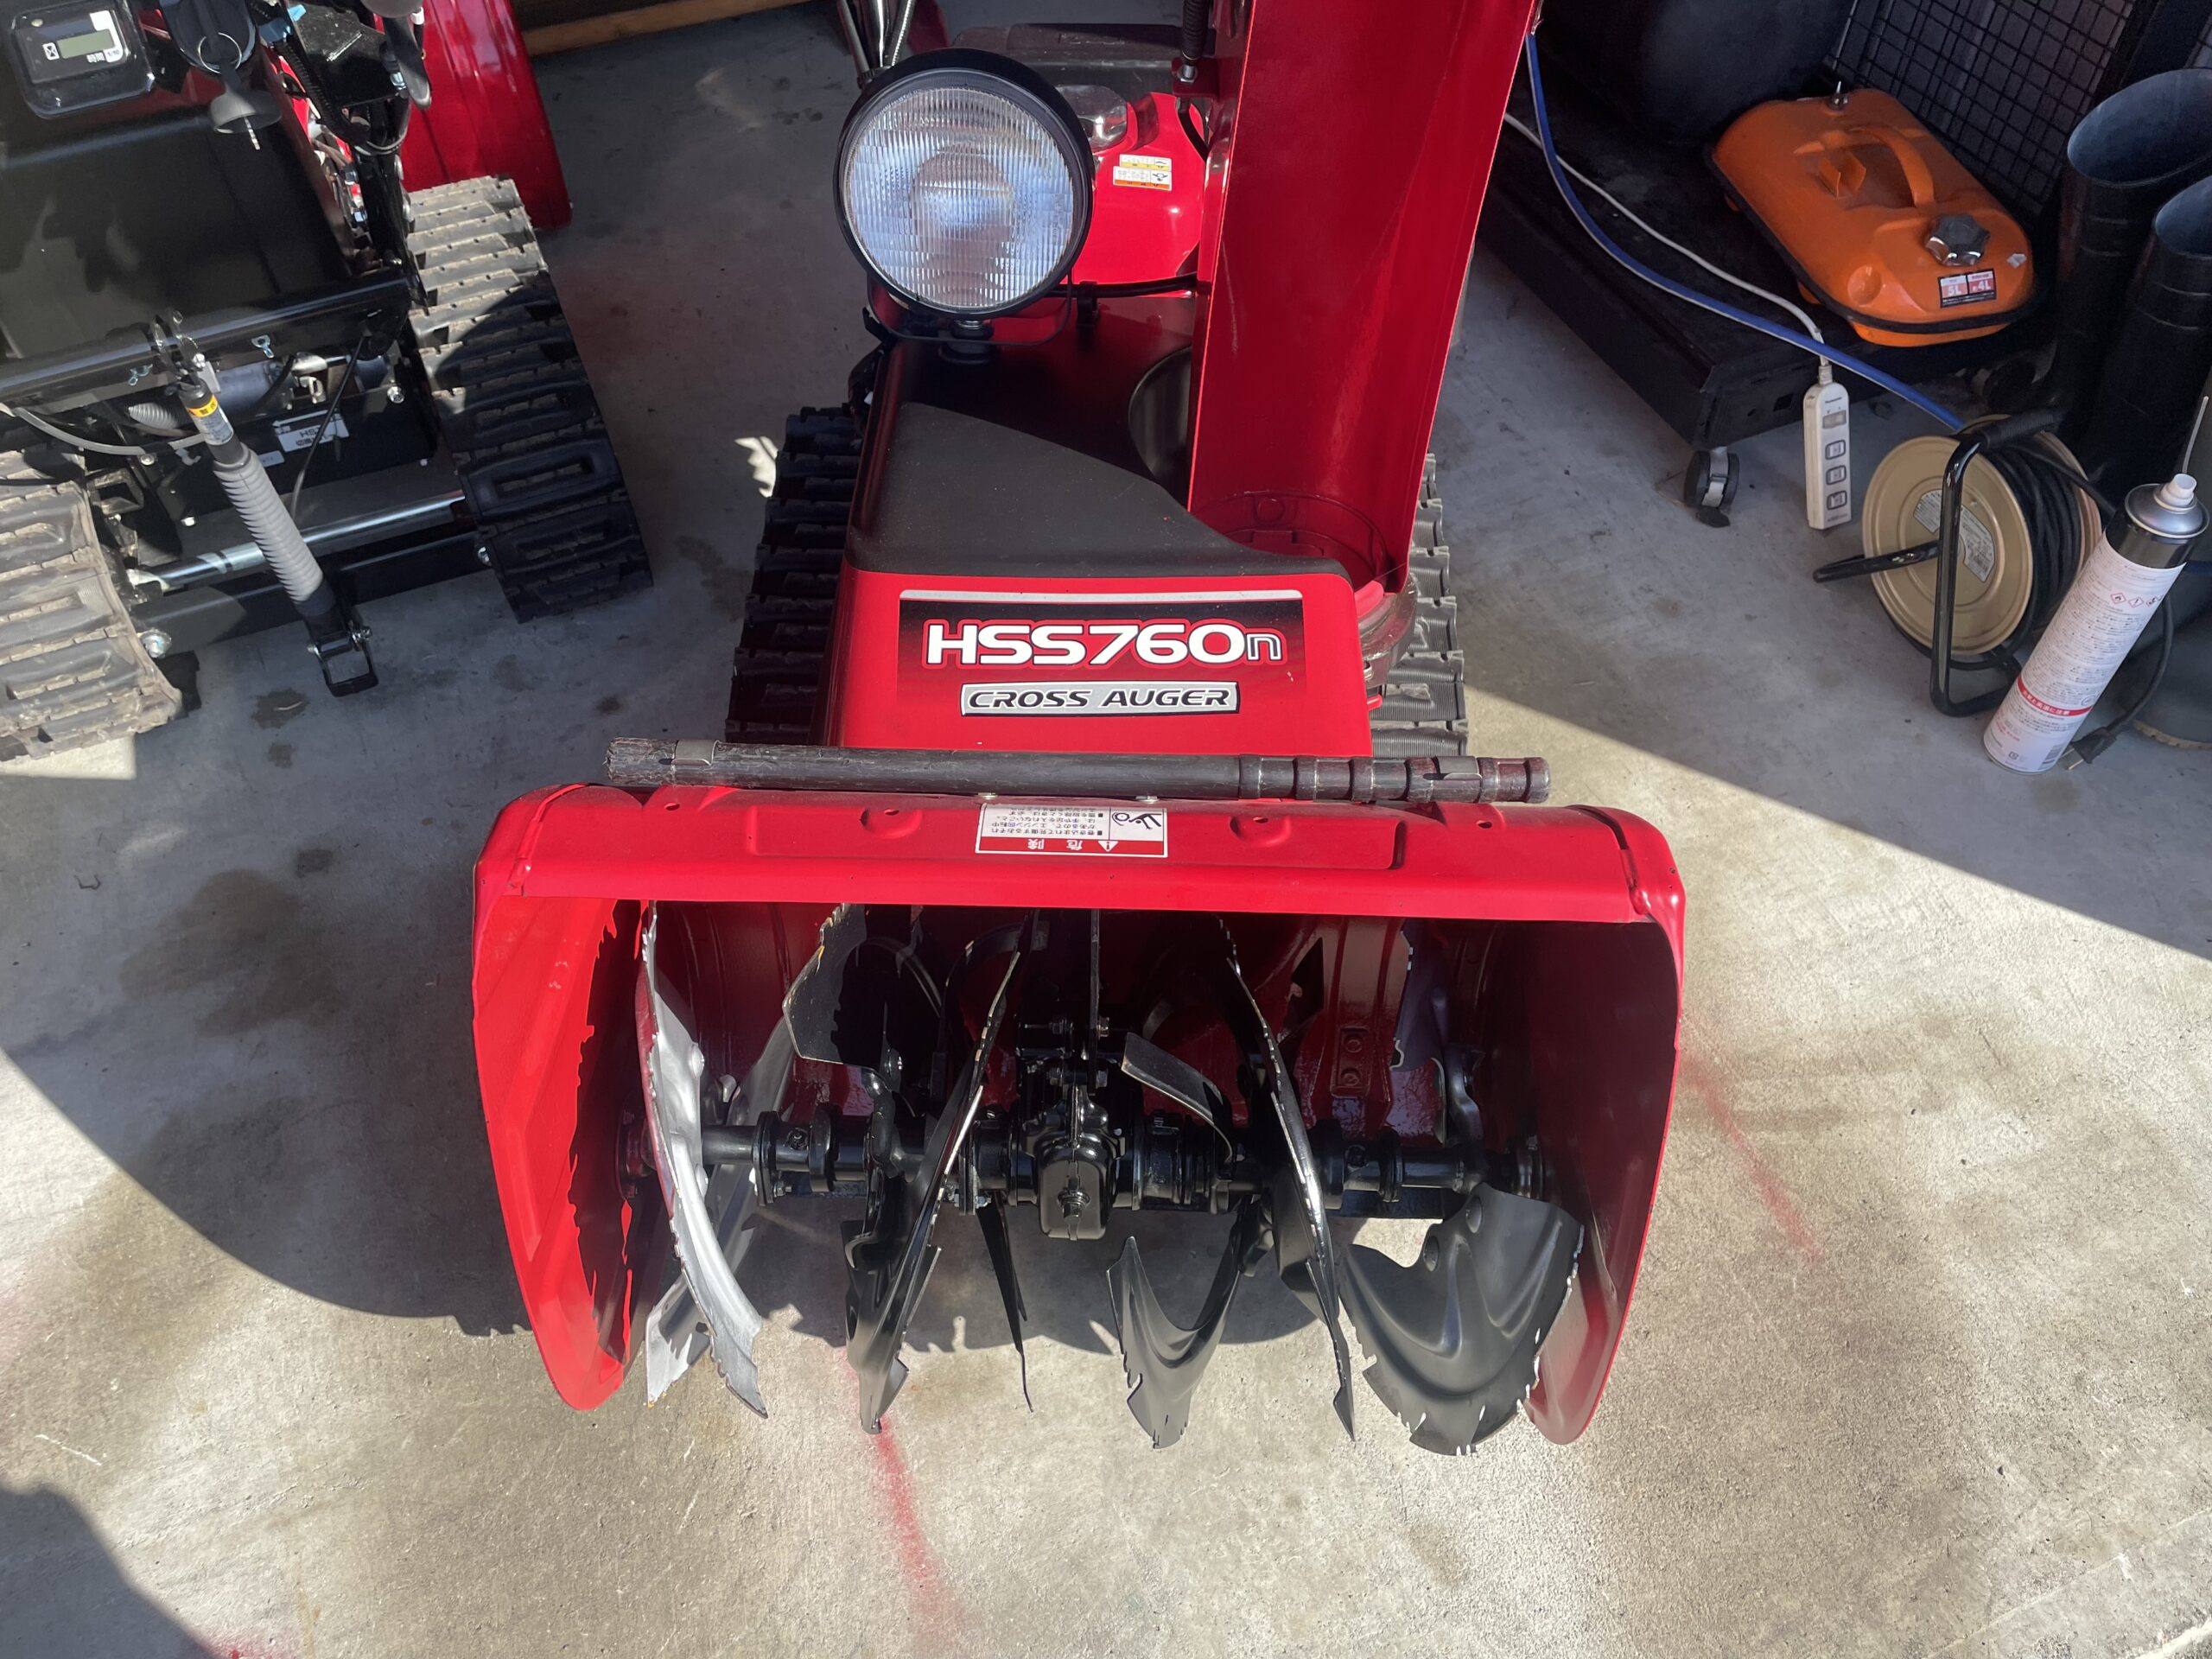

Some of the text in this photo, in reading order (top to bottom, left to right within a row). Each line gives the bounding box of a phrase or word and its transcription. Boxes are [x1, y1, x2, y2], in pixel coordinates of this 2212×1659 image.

[926, 623, 1283, 665] HSS760n
[969, 689, 1230, 709] CROSS AUGER
[1027, 839, 1084, 851] 危険
